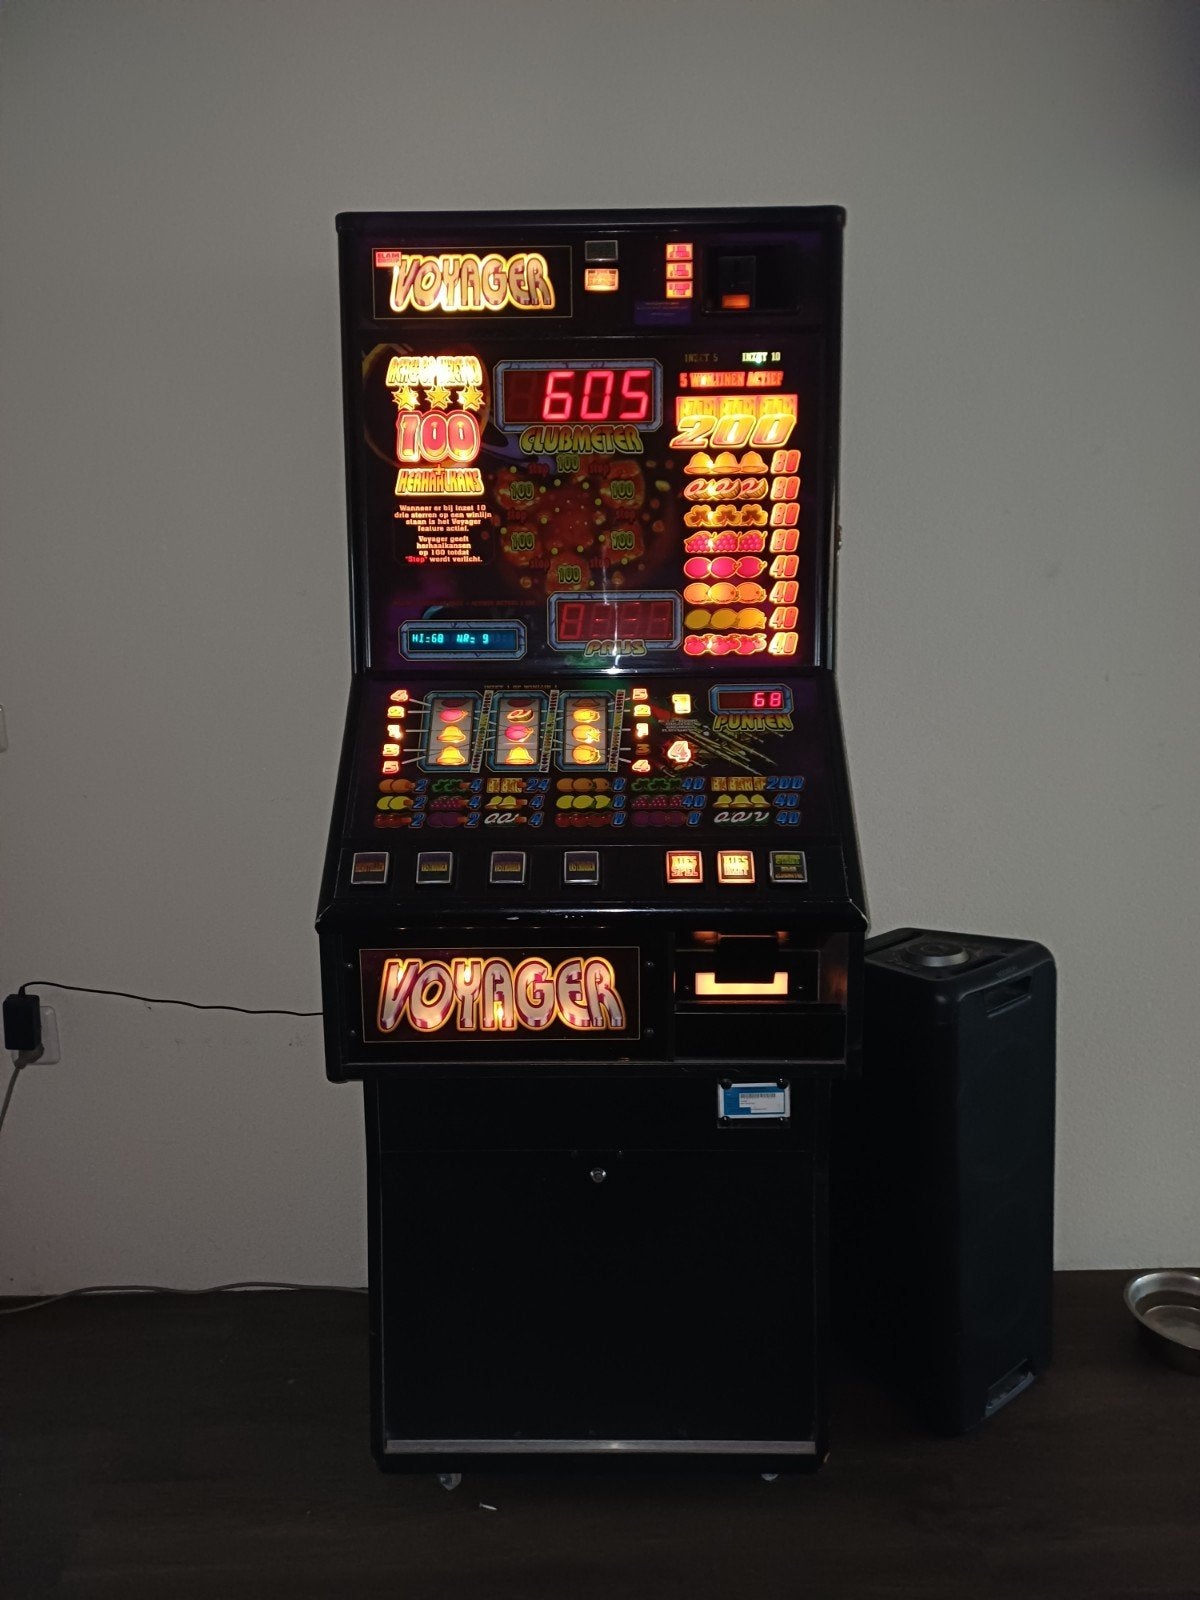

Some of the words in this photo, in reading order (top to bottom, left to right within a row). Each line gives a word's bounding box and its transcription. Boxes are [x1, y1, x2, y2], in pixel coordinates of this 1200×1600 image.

[390, 253, 556, 312] VOYAGER
[771, 351, 781, 361] 10
[542, 370, 651, 420] 605
[396, 410, 480, 462] 100
[519, 425, 644, 455] CLUBMETER
[670, 413, 796, 449] 200
[556, 453, 580, 473] 100
[510, 481, 534, 500] 100
[611, 480, 635, 499] 100
[511, 531, 535, 550] 100
[611, 531, 635, 551] 100
[557, 564, 581, 584] 100
[482, 633, 489, 644] 9
[584, 639, 647, 657] PRIJS
[753, 692, 782, 707] 68
[712, 713, 794, 732] PUNTEN
[667, 740, 692, 763] 4
[631, 760, 651, 773] 4
[470, 778, 484, 792] 4
[525, 778, 550, 792] 24
[411, 795, 427, 810] 2
[467, 795, 482, 809] 4
[529, 795, 544, 809] 4
[409, 812, 425, 827] 2
[464, 812, 480, 827] 2
[528, 812, 544, 826] 4
[377, 957, 625, 1031] VOYAGER
